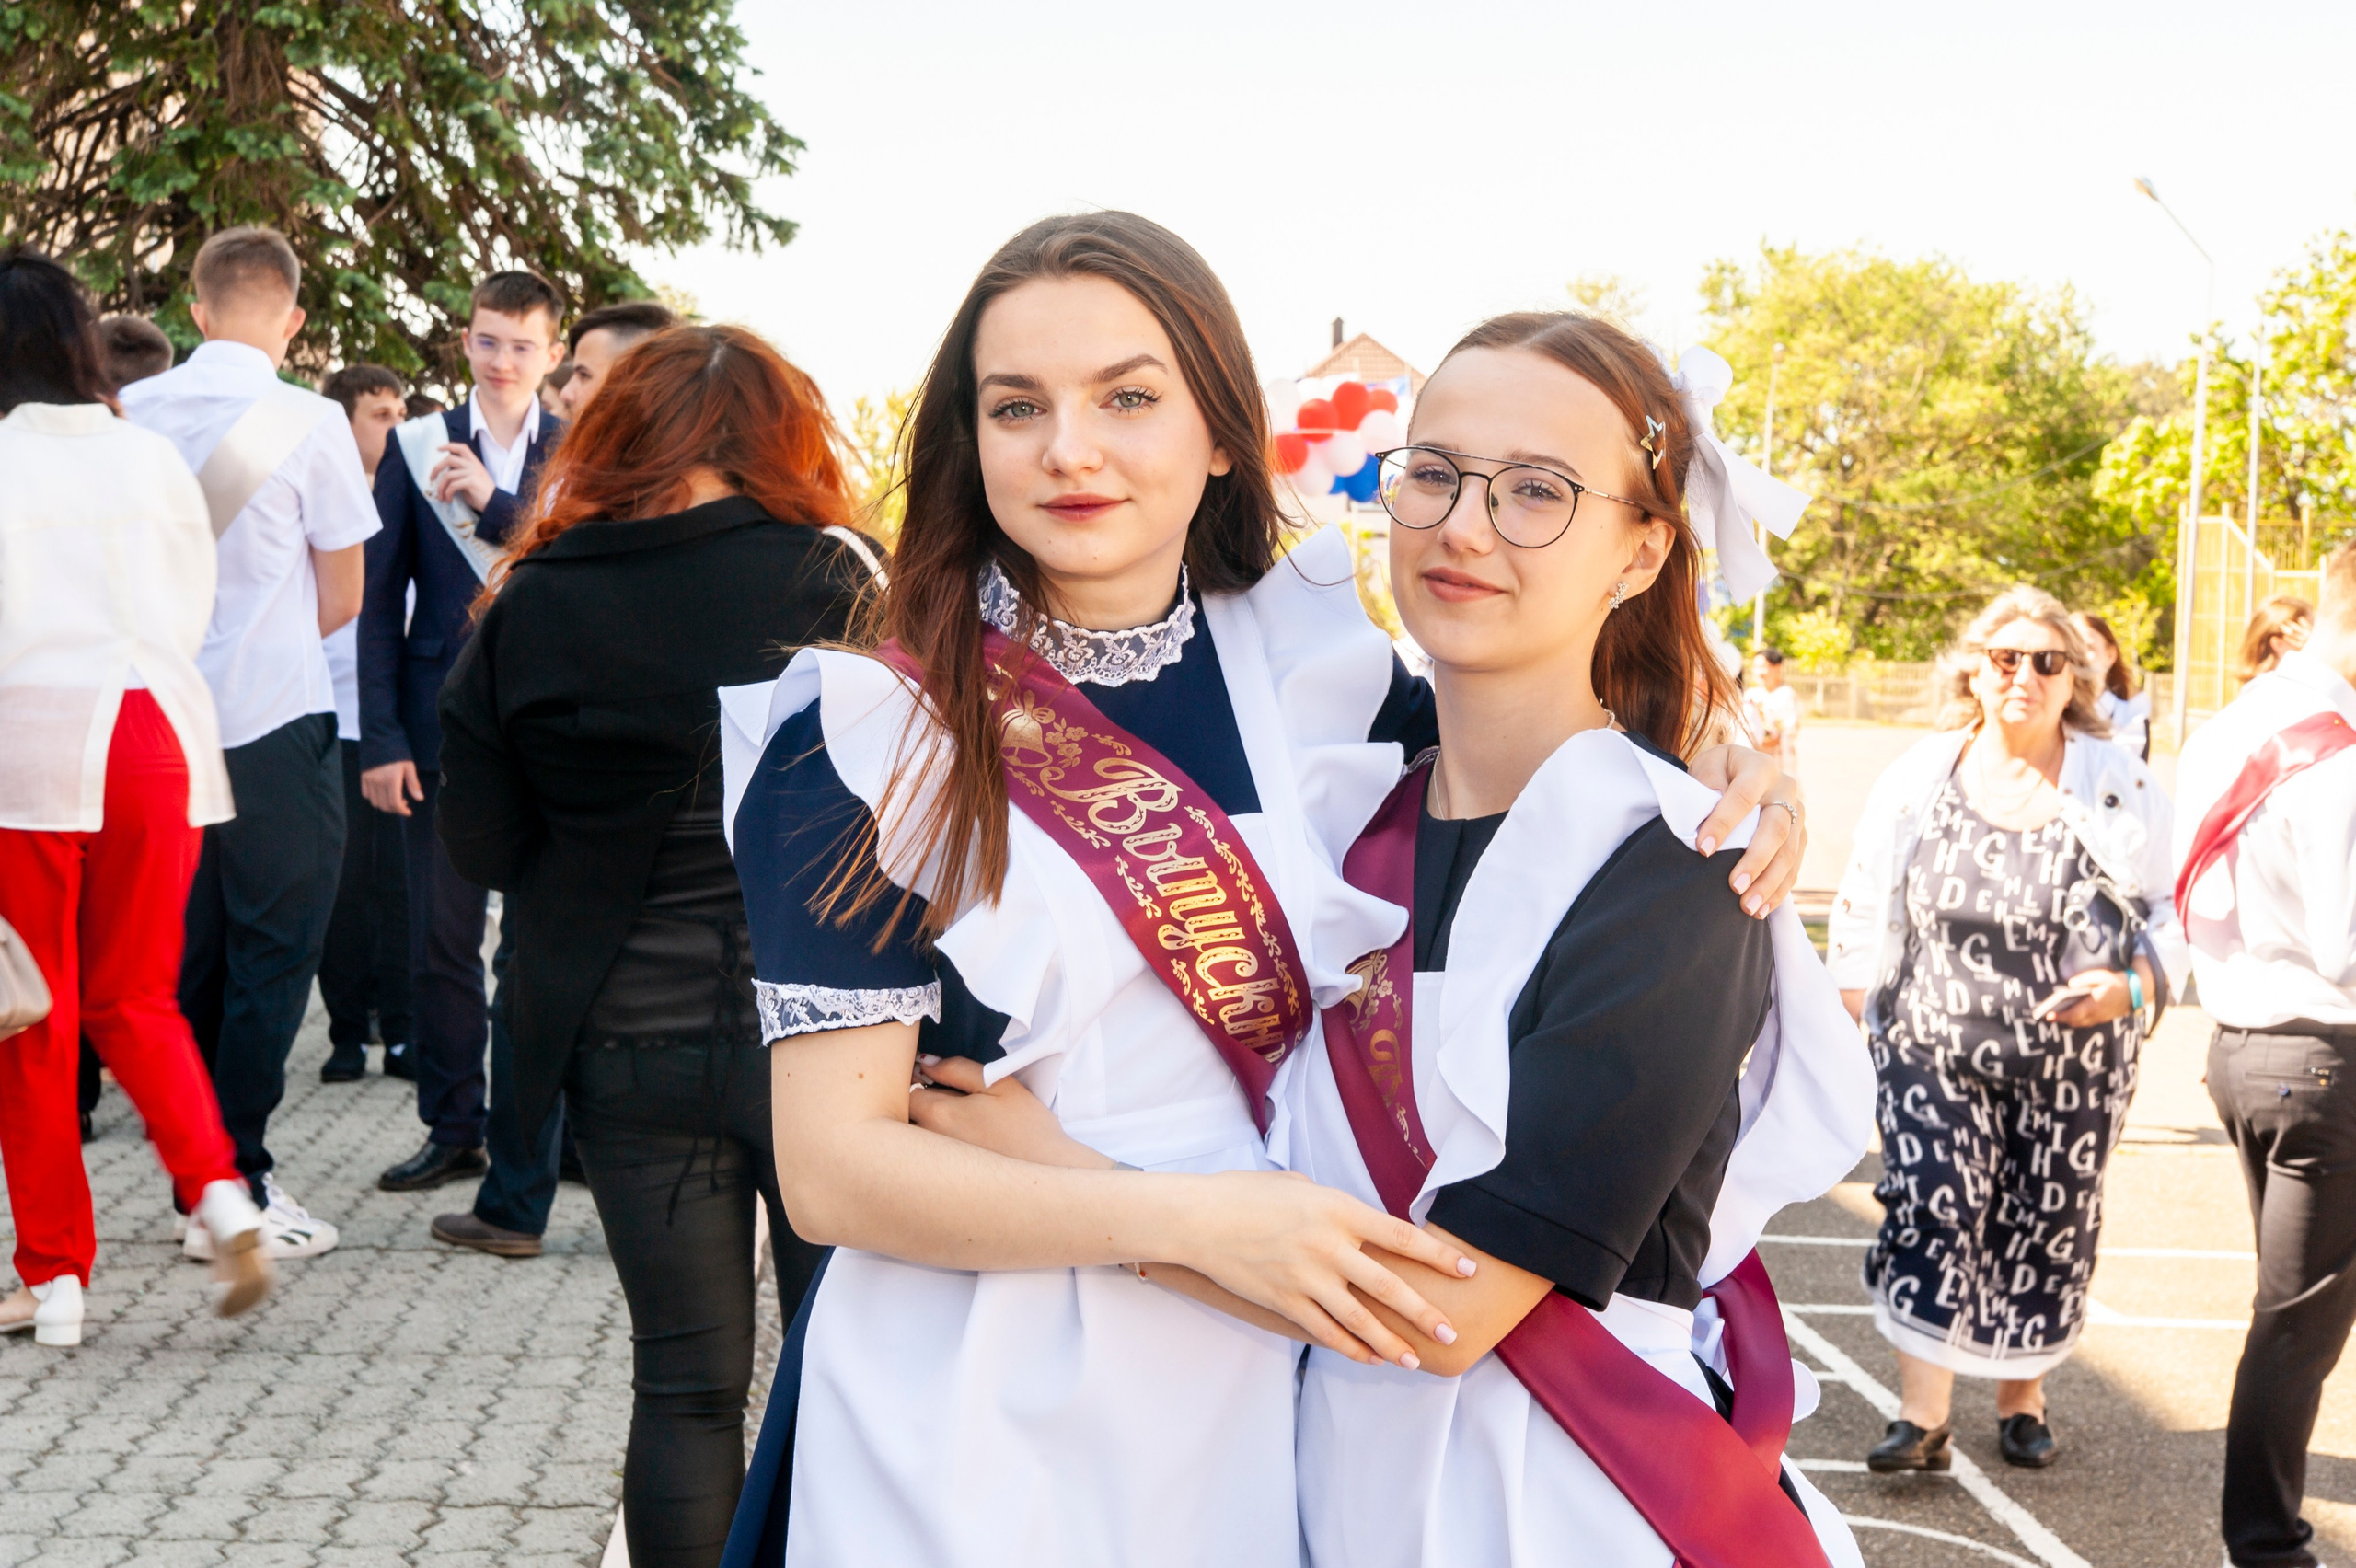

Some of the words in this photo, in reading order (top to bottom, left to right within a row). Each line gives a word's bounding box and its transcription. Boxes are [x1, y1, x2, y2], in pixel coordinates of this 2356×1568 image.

[1936, 876, 1967, 910] D
[1960, 933, 1993, 975] G
[1946, 979, 1970, 1015] D
[1971, 1039, 2004, 1078] G
[2055, 1080, 2080, 1112] D
[2030, 1141, 2052, 1178] H
[2068, 1131, 2096, 1172] G
[2039, 1182, 2066, 1213] D
[2045, 1226, 2076, 1259] G
[1888, 1275, 1921, 1320] G
